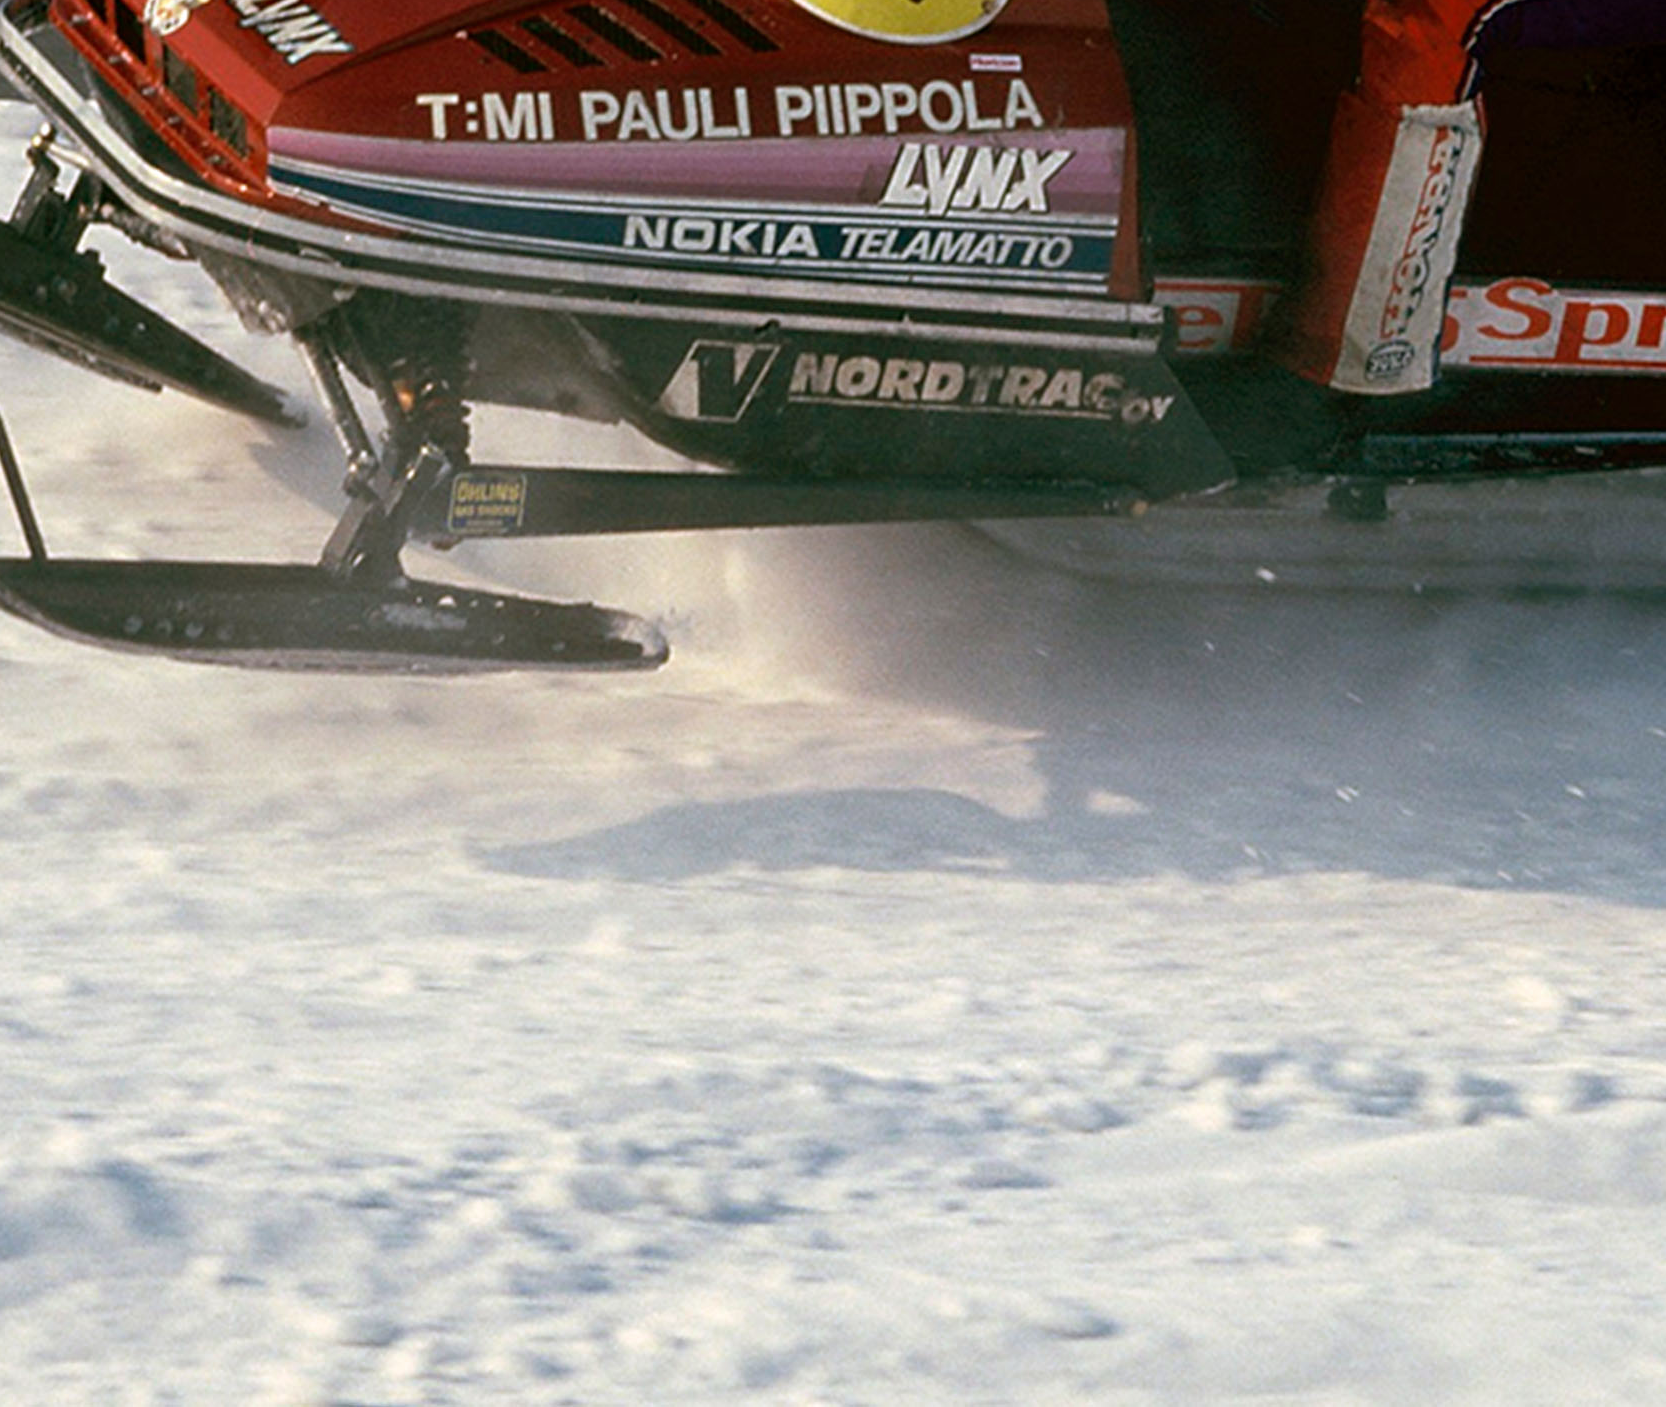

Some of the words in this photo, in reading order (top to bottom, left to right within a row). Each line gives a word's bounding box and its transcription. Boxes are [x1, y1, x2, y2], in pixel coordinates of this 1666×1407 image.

[416, 92, 555, 141] T:MI
[580, 86, 752, 141] PAULI
[775, 78, 1044, 136] PIIPPOLA
[880, 142, 1074, 218] LYNX
[622, 215, 821, 259] NOKIA
[839, 225, 1074, 269] TELAMATTO
[1380, 125, 1466, 341] HONDA
